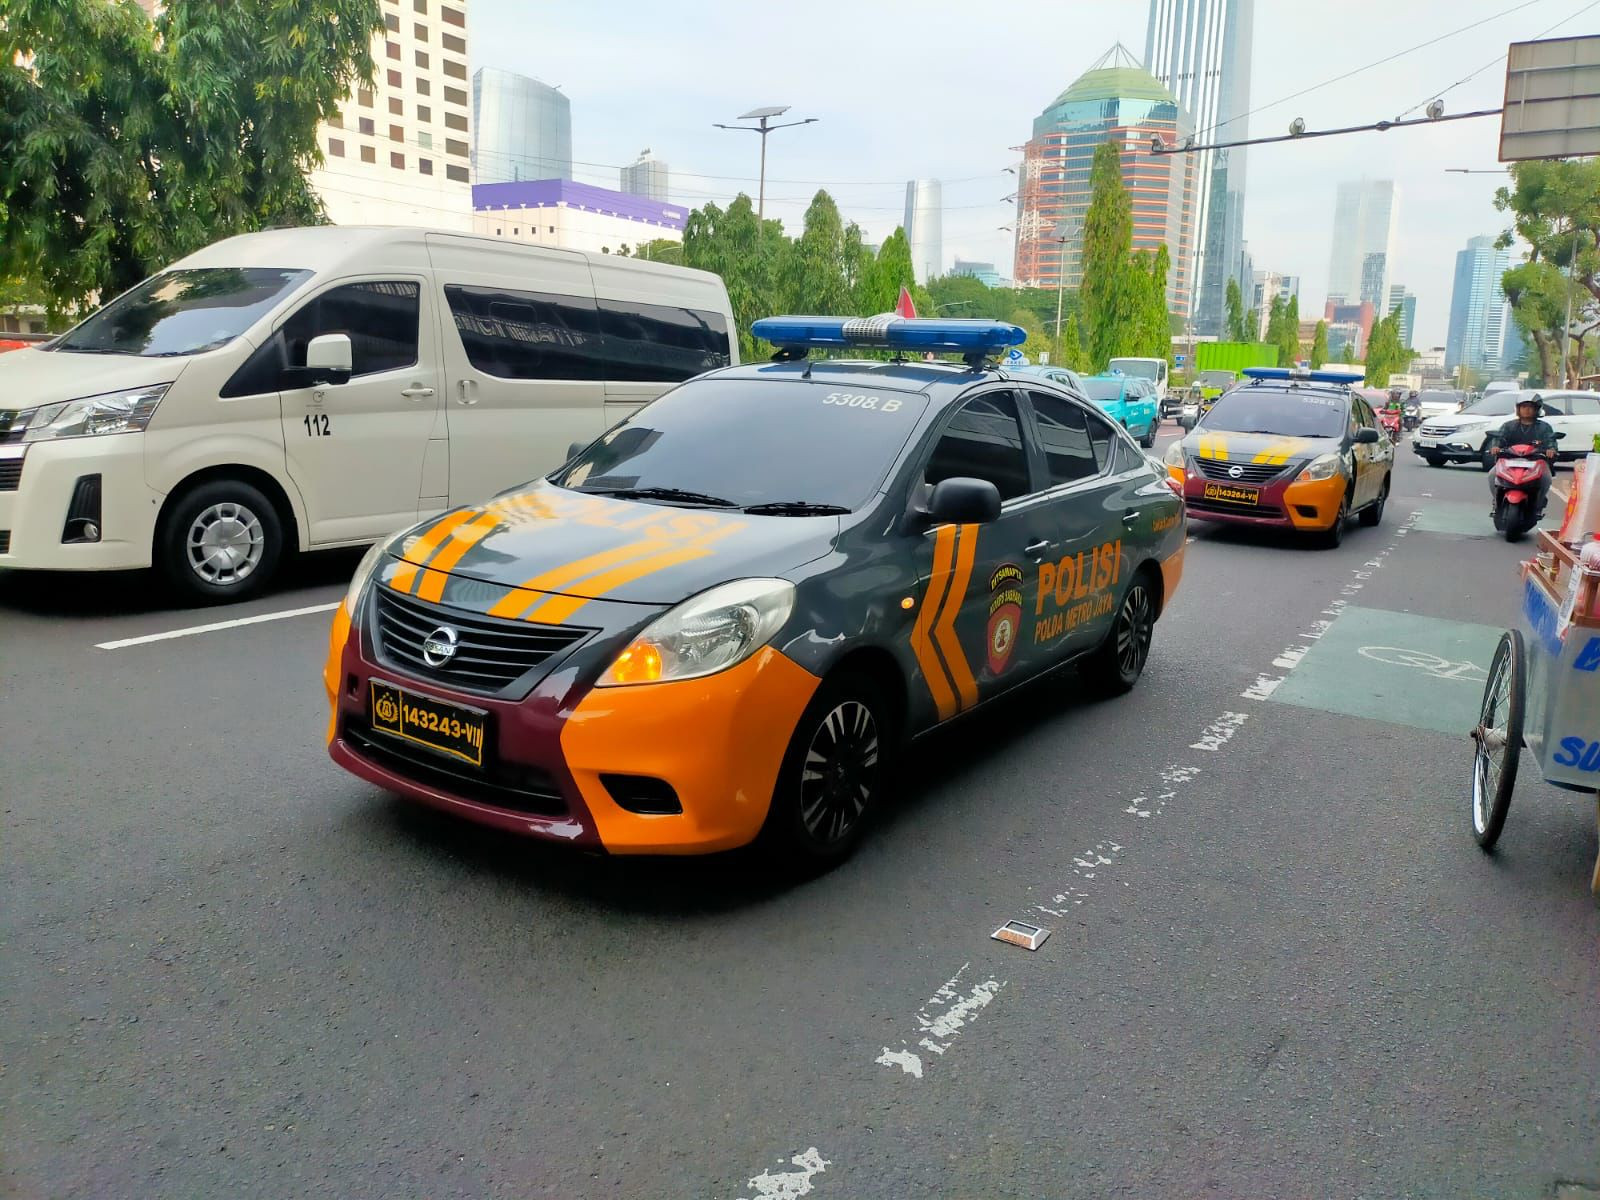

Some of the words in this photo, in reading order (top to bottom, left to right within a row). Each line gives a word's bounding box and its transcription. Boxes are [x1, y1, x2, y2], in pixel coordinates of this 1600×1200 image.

[303, 414, 331, 437] 112
[1035, 539, 1121, 615] POLISI
[1065, 600, 1093, 631] METRO
[1093, 592, 1113, 617] JAYA
